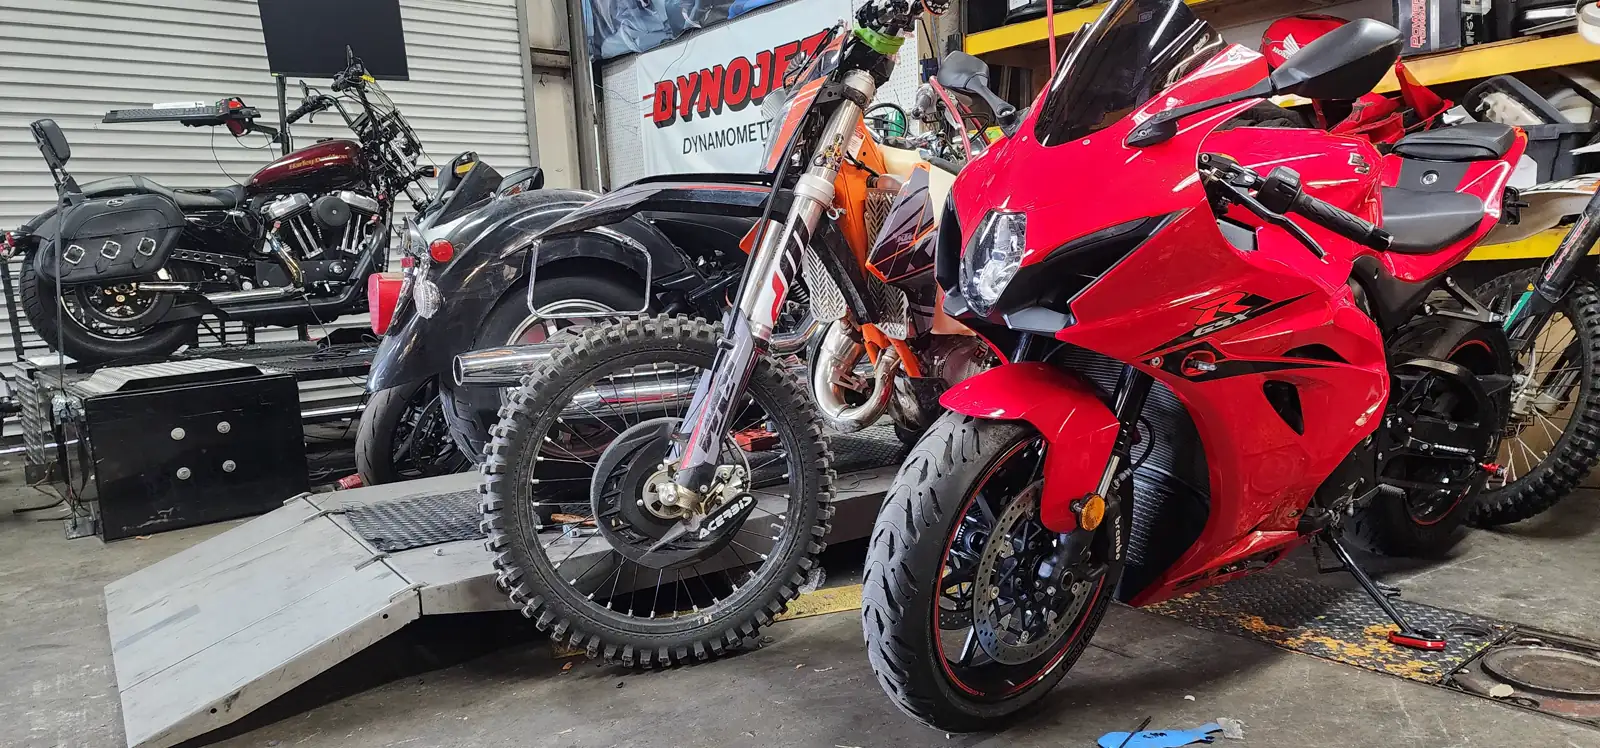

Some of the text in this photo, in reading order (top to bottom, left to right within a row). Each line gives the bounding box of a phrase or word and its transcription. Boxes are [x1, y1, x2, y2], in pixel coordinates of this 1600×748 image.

[683, 118, 774, 154] DYNAMOMET
[700, 496, 753, 539] ACERBIS
[1114, 515, 1122, 560] brembo
